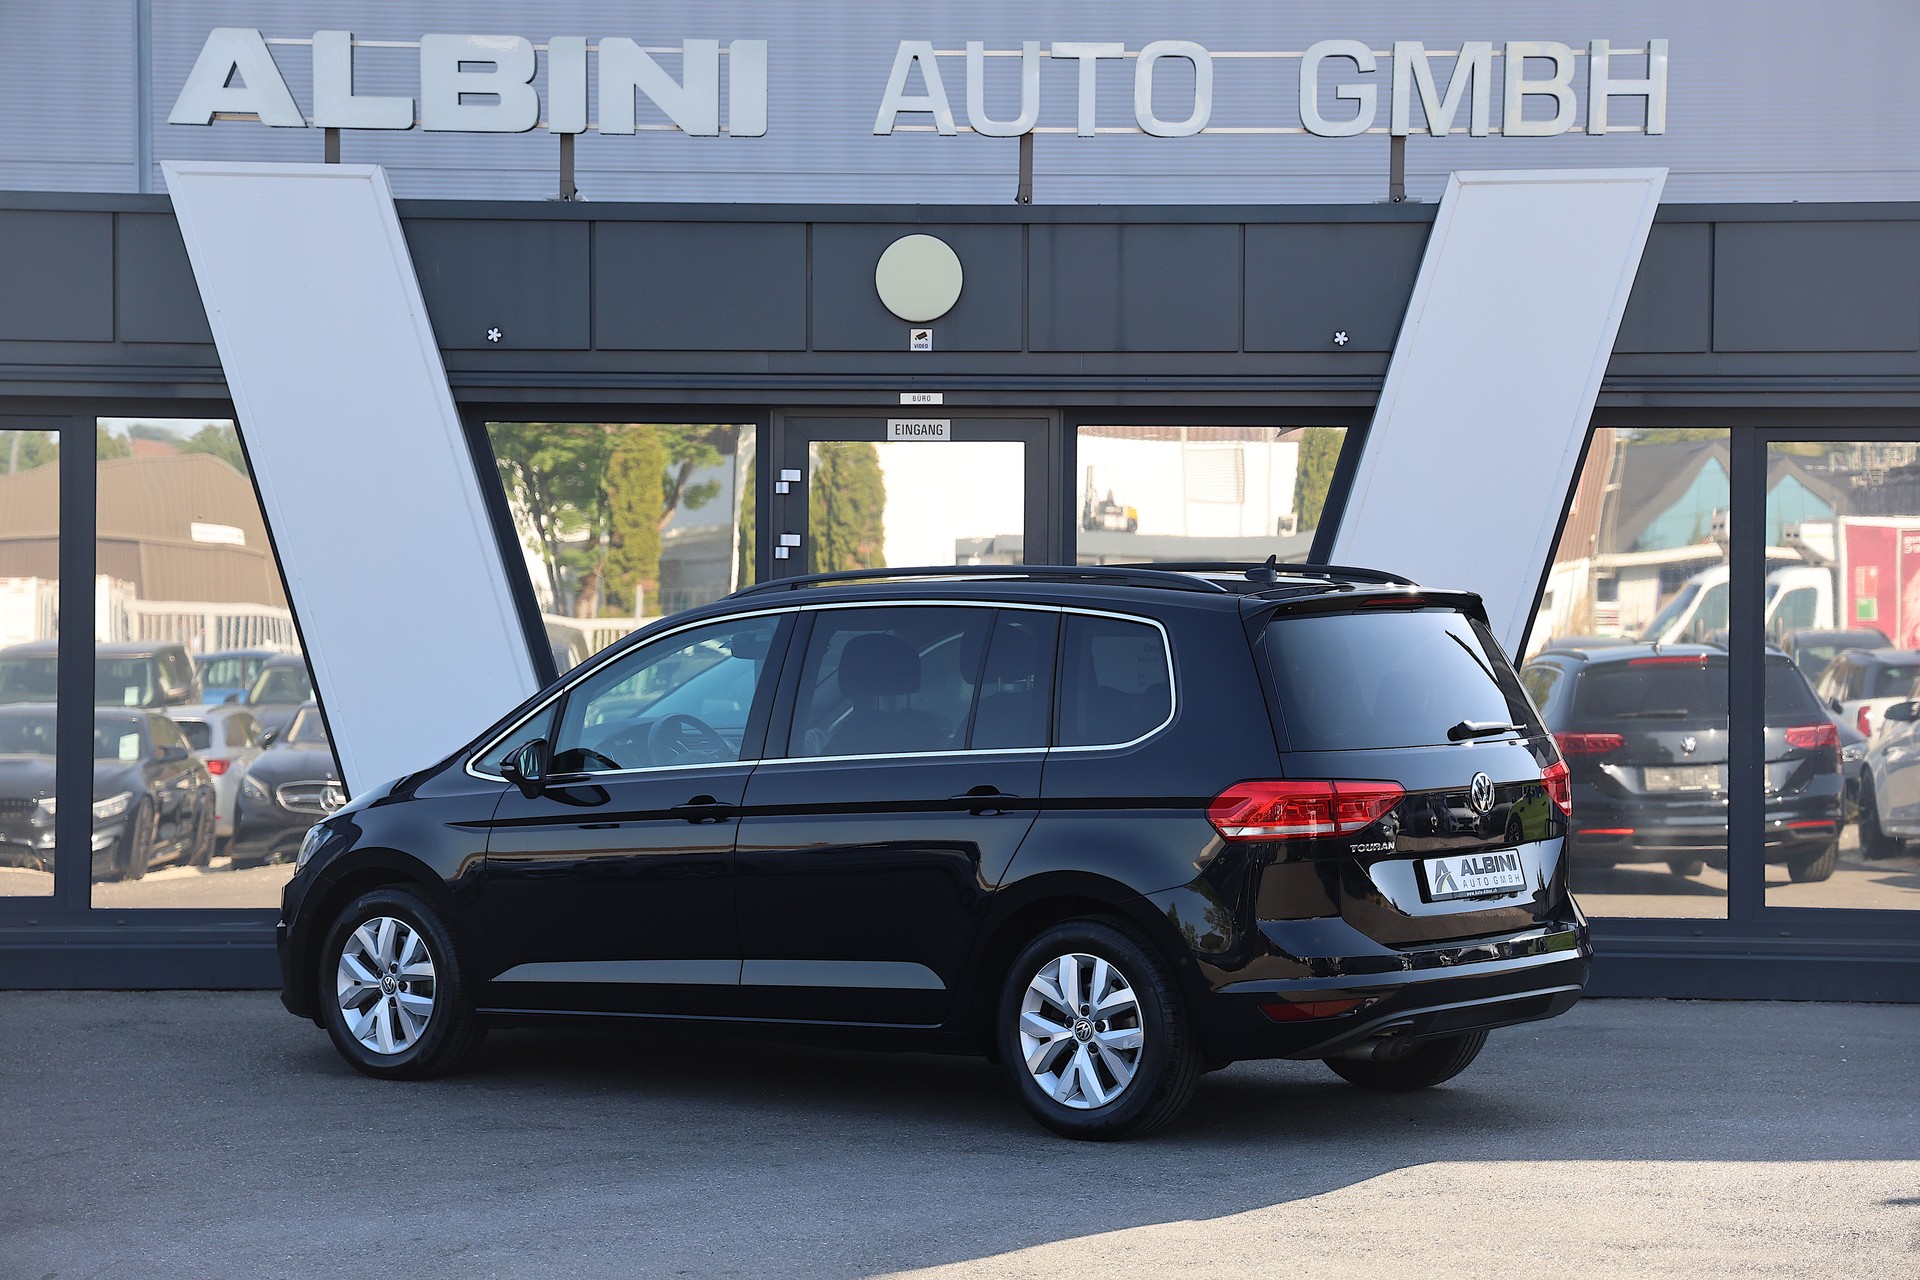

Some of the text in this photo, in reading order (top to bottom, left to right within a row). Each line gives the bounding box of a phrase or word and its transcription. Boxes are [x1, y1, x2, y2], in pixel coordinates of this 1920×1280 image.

[167, 27, 1669, 138] ALBINI AUTO GMBH
[912, 394, 932, 402] BÜRO
[895, 423, 943, 436] EINGANG
[1350, 841, 1395, 853] TOURAN
[1461, 854, 1517, 876] ALBINI
[1462, 873, 1521, 889] AUTO GMBH
